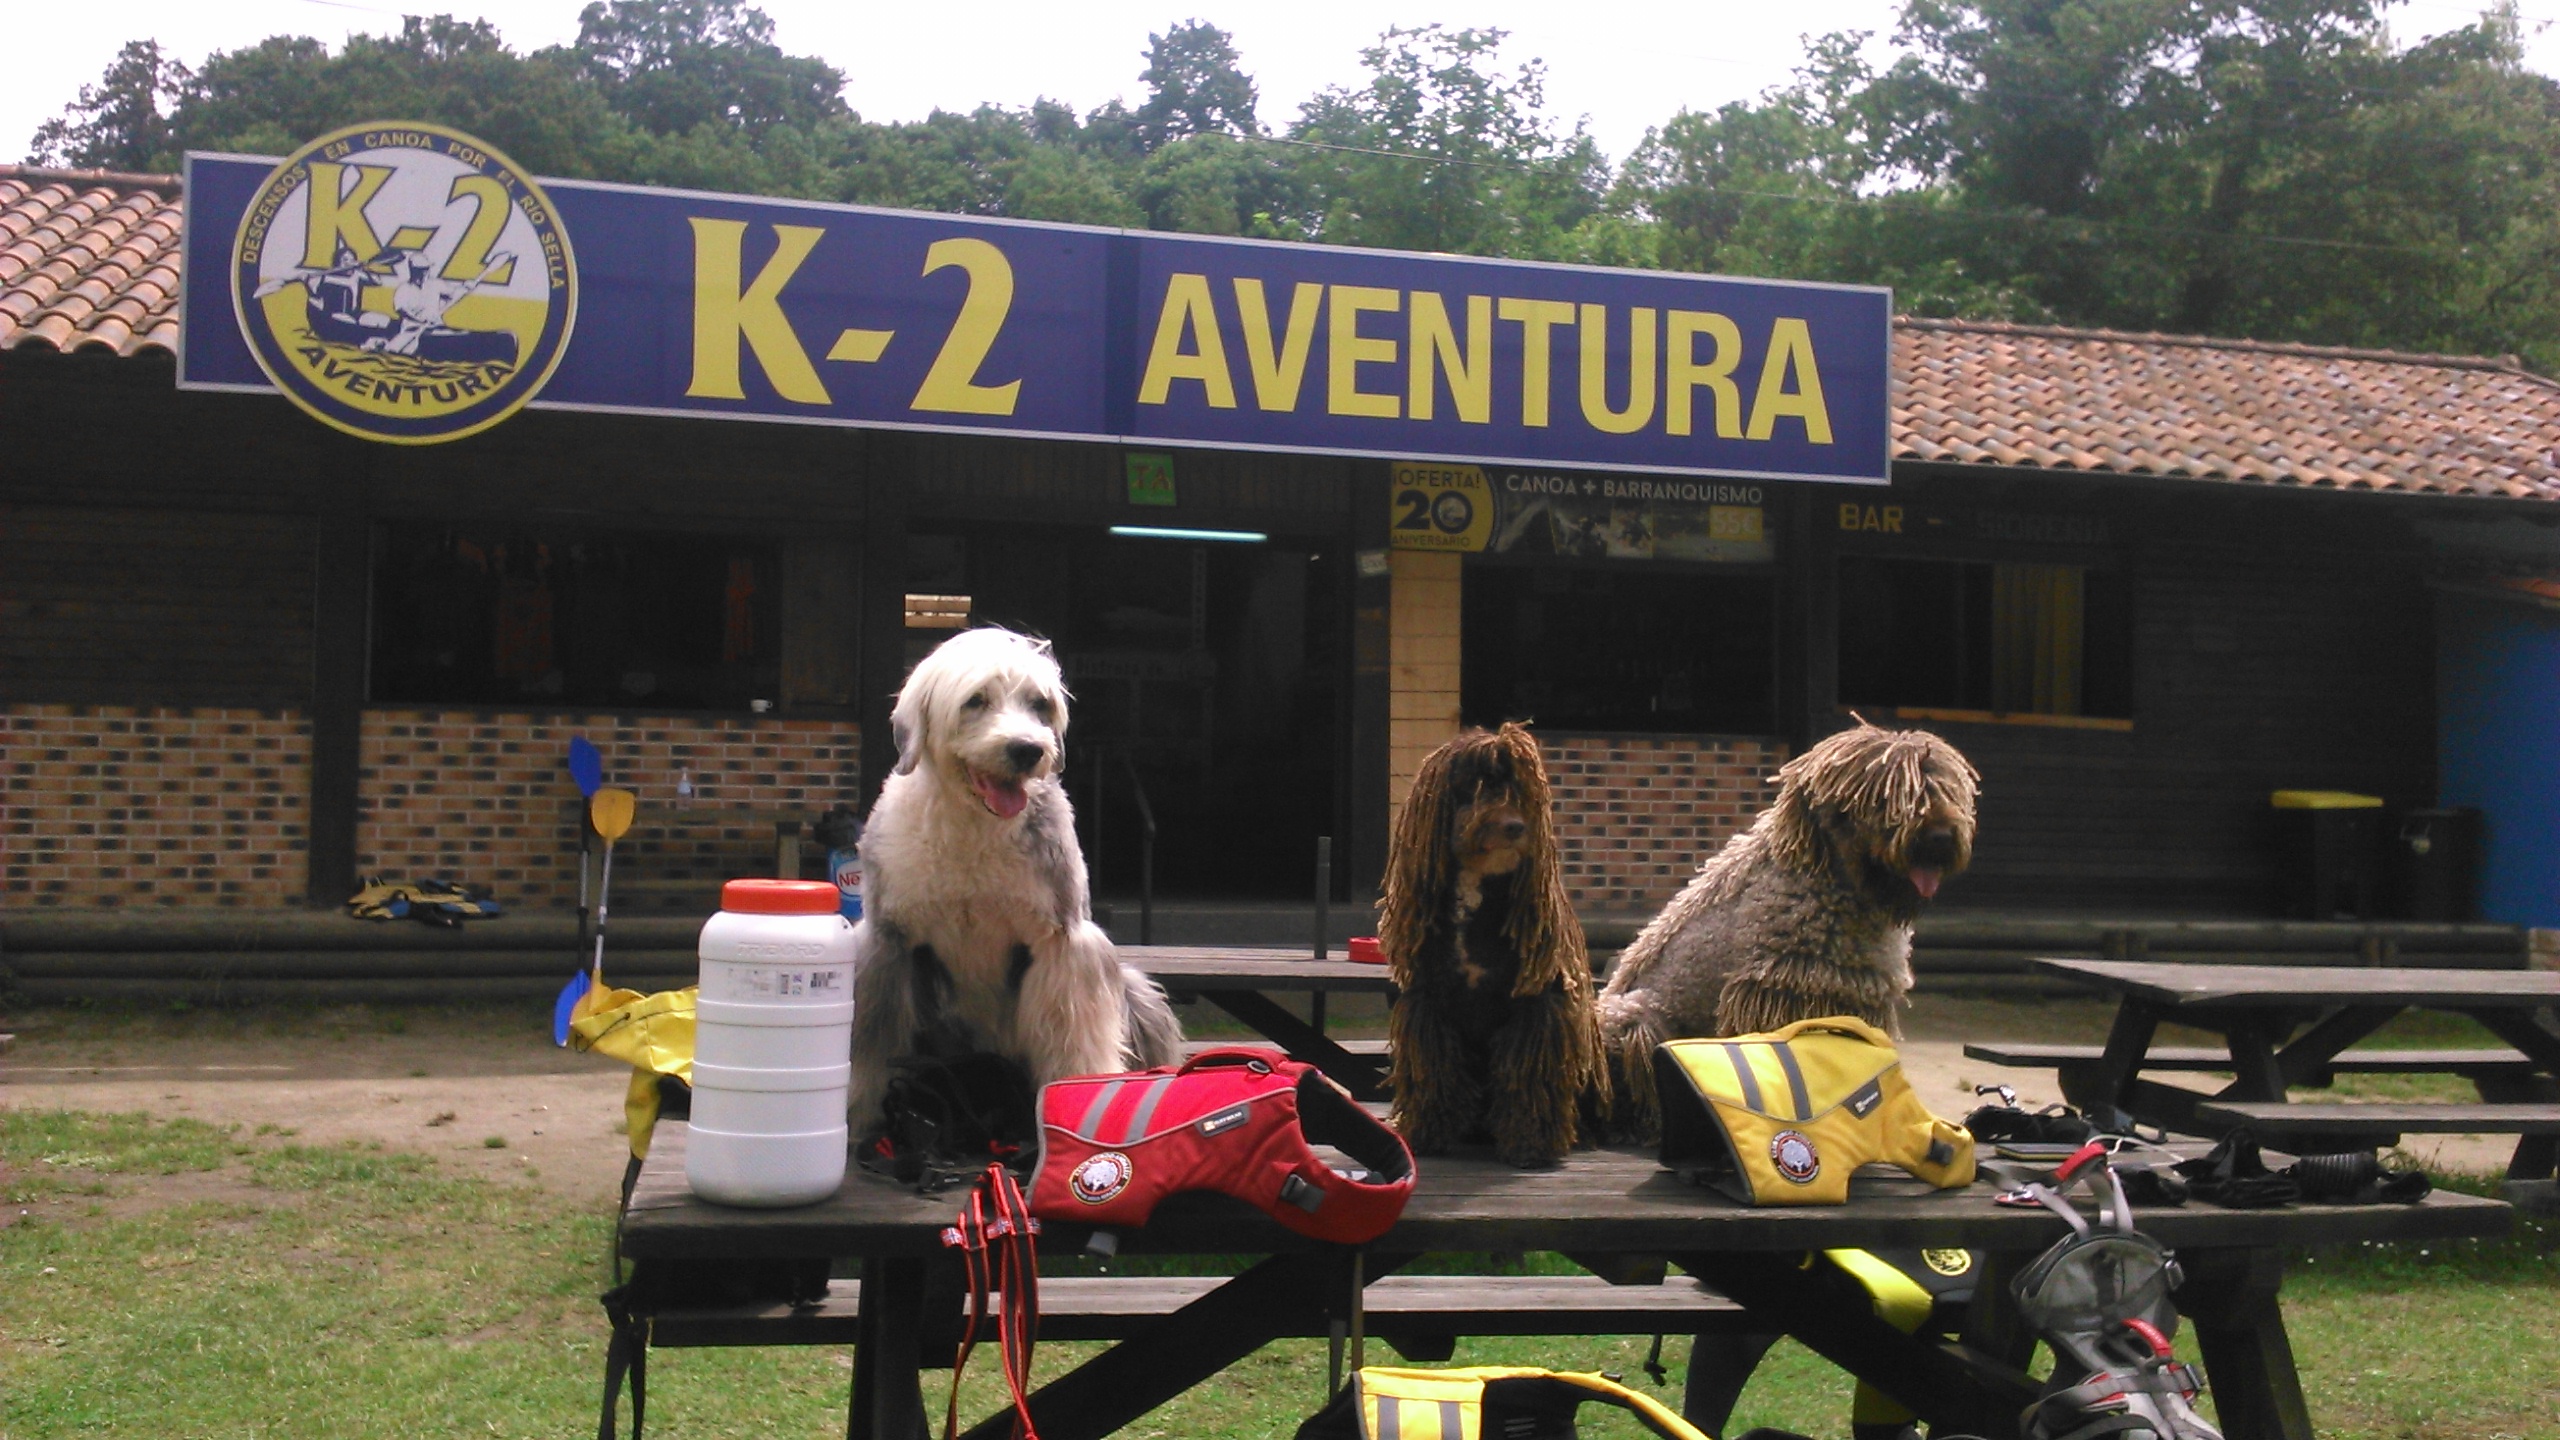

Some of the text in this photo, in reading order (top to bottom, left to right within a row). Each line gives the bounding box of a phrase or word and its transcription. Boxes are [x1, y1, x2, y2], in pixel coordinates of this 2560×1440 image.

[243, 166, 306, 263] DESCENSOS
[324, 141, 350, 159] EN
[365, 132, 432, 149] CANOA
[448, 142, 486, 168] POR
[497, 169, 515, 194] EL
[541, 232, 565, 288] SELLA
[295, 162, 518, 286] K-2
[685, 217, 1022, 416] K-2
[297, 347, 514, 405] AVENTURA
[1138, 273, 1834, 445] AVENTURA
[1393, 469, 1480, 489] ¡OFERTA!
[1506, 474, 1577, 495] CANOA
[1604, 480, 1763, 503] BARRANQUISMO
[1395, 490, 1474, 534] 20
[1839, 503, 1903, 533] BAR
[1391, 535, 1470, 547] ANIVERSARIO
